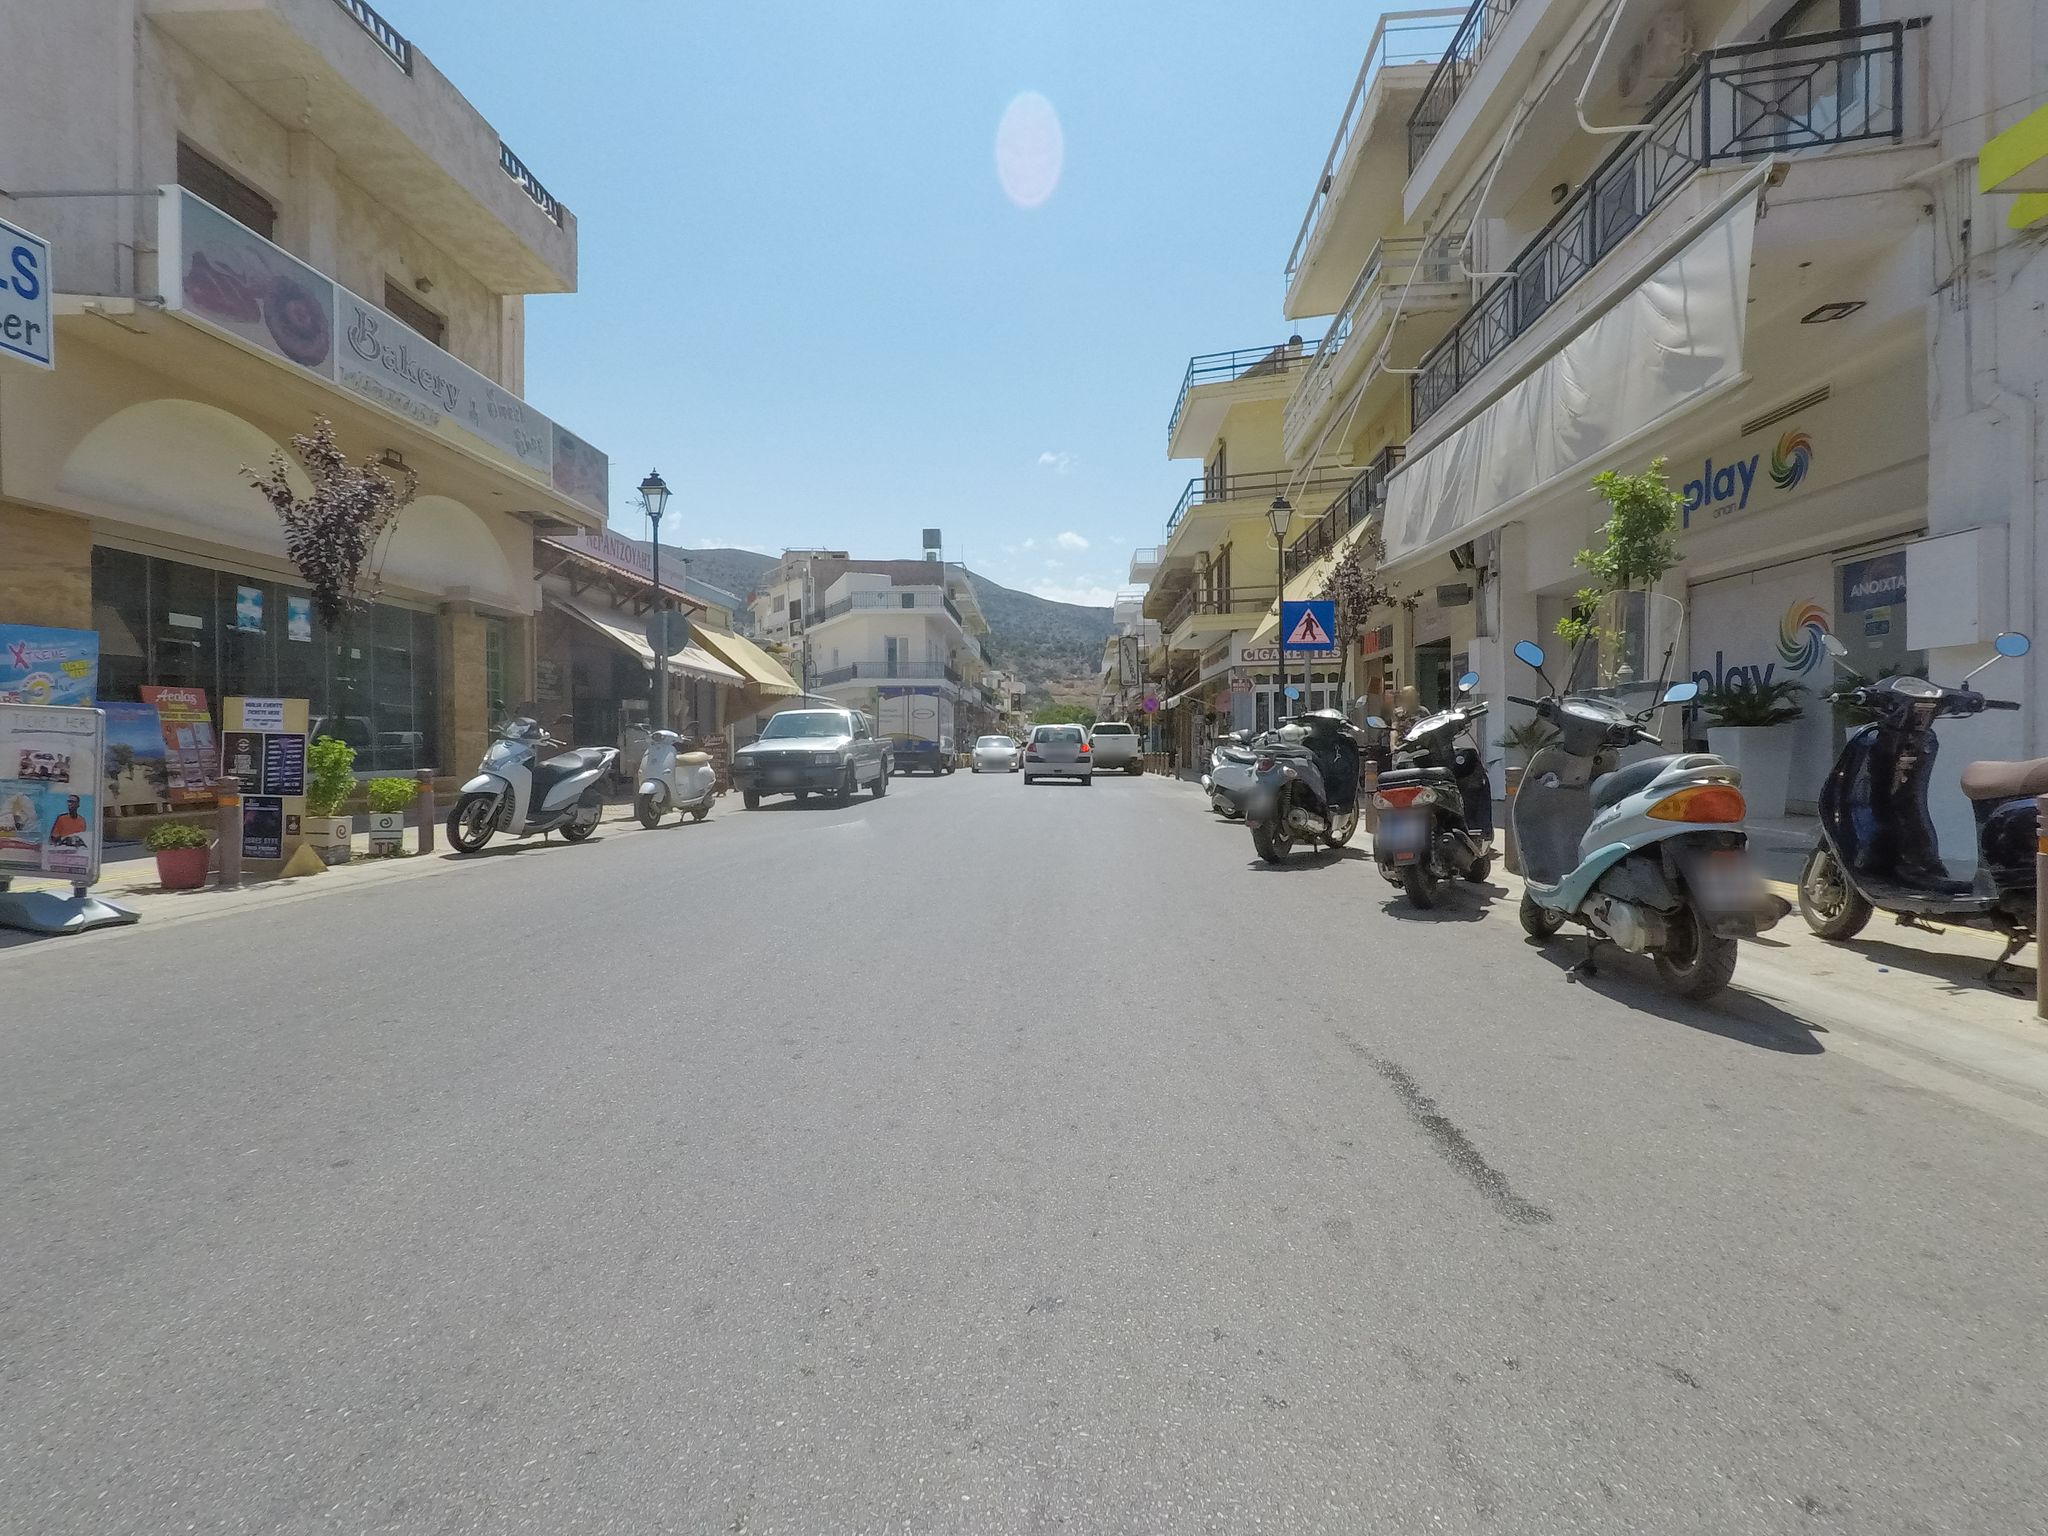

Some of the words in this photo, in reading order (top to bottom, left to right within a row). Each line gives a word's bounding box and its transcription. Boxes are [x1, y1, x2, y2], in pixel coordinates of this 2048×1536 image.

[0, 245, 40, 300] S
[347, 307, 460, 412] Bakery
[1683, 453, 1759, 529] play
[1243, 646, 1341, 662] CIGARETES
